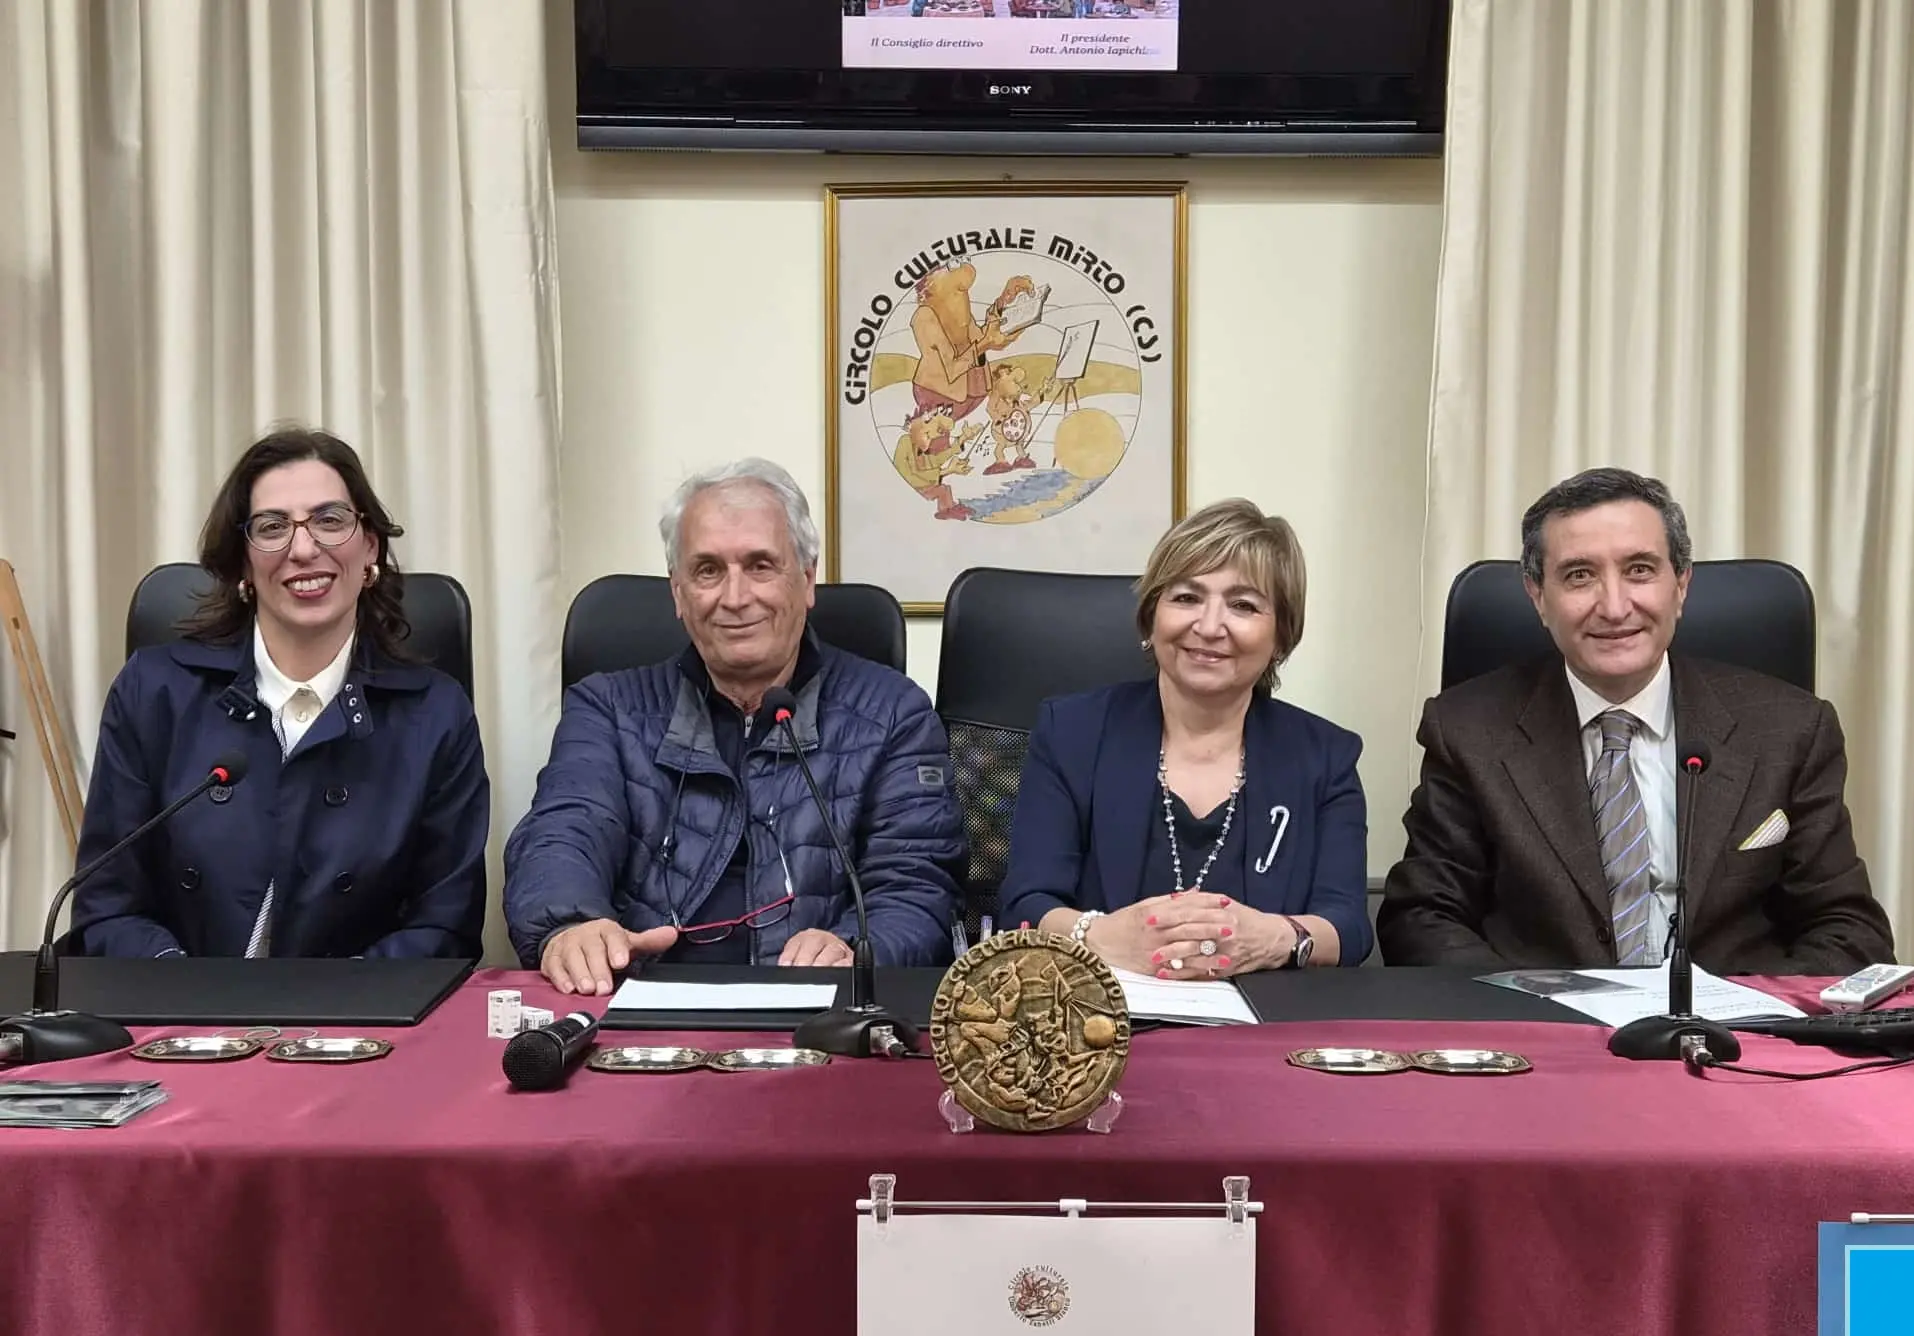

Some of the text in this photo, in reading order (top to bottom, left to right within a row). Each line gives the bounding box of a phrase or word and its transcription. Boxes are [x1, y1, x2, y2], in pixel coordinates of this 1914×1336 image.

[870, 37, 984, 49] Il Consiglio direttivo
[1060, 33, 1131, 45] Il presidente
[1029, 45, 1057, 55] Dott.
[1059, 45, 1105, 55] Antonio
[989, 85, 1032, 96] SONY
[894, 227, 1036, 290] CULTURALE
[1125, 304, 1162, 363] (CS)
